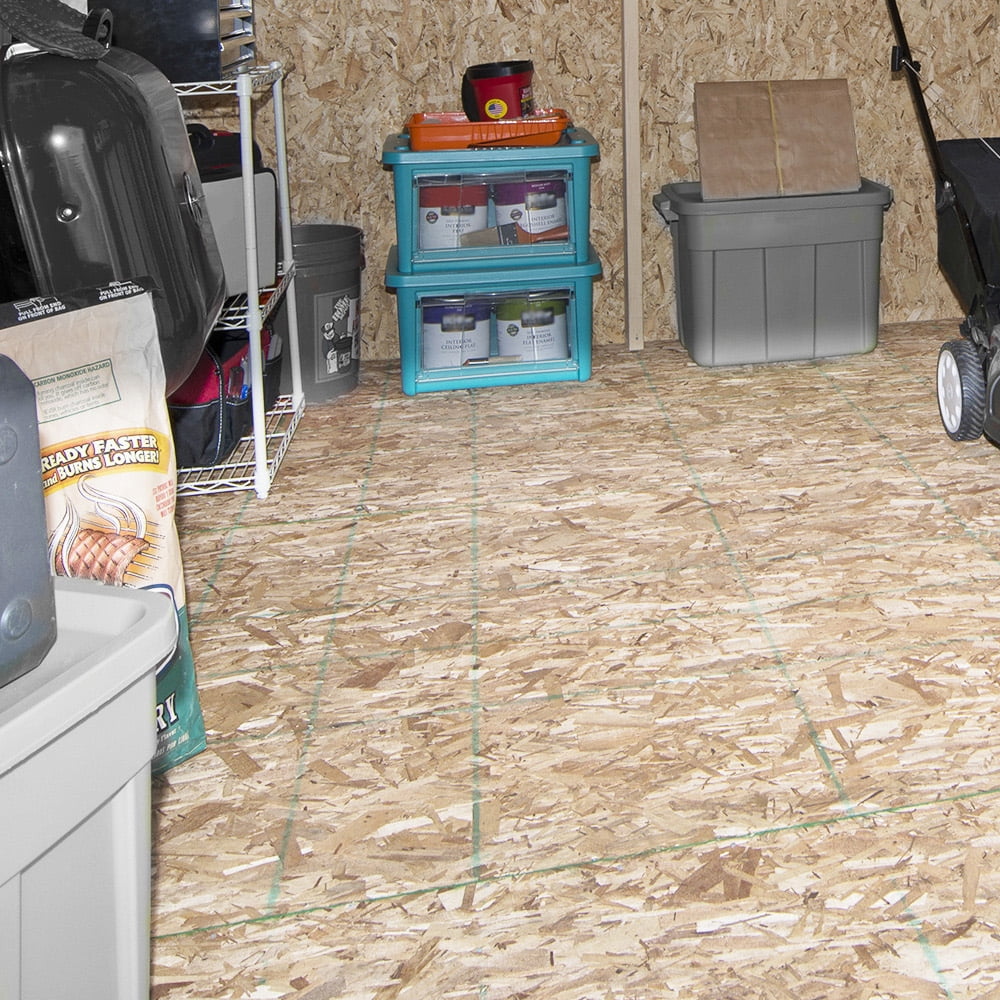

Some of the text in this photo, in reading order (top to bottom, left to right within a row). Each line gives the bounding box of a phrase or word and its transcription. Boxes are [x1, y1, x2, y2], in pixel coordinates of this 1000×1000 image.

[100, 288, 115, 297] PULL
[107, 291, 125, 300] FRONT
[18, 301, 62, 317] PULL FROM END
[27, 311, 46, 320] FRONT
[54, 305, 66, 314] BAG
[33, 361, 111, 388] CARBON MONOXIDE HAZARD
[41, 434, 158, 473] READY FASTER
[58, 456, 102, 481] BURNS
[104, 450, 160, 468] LONGER!
